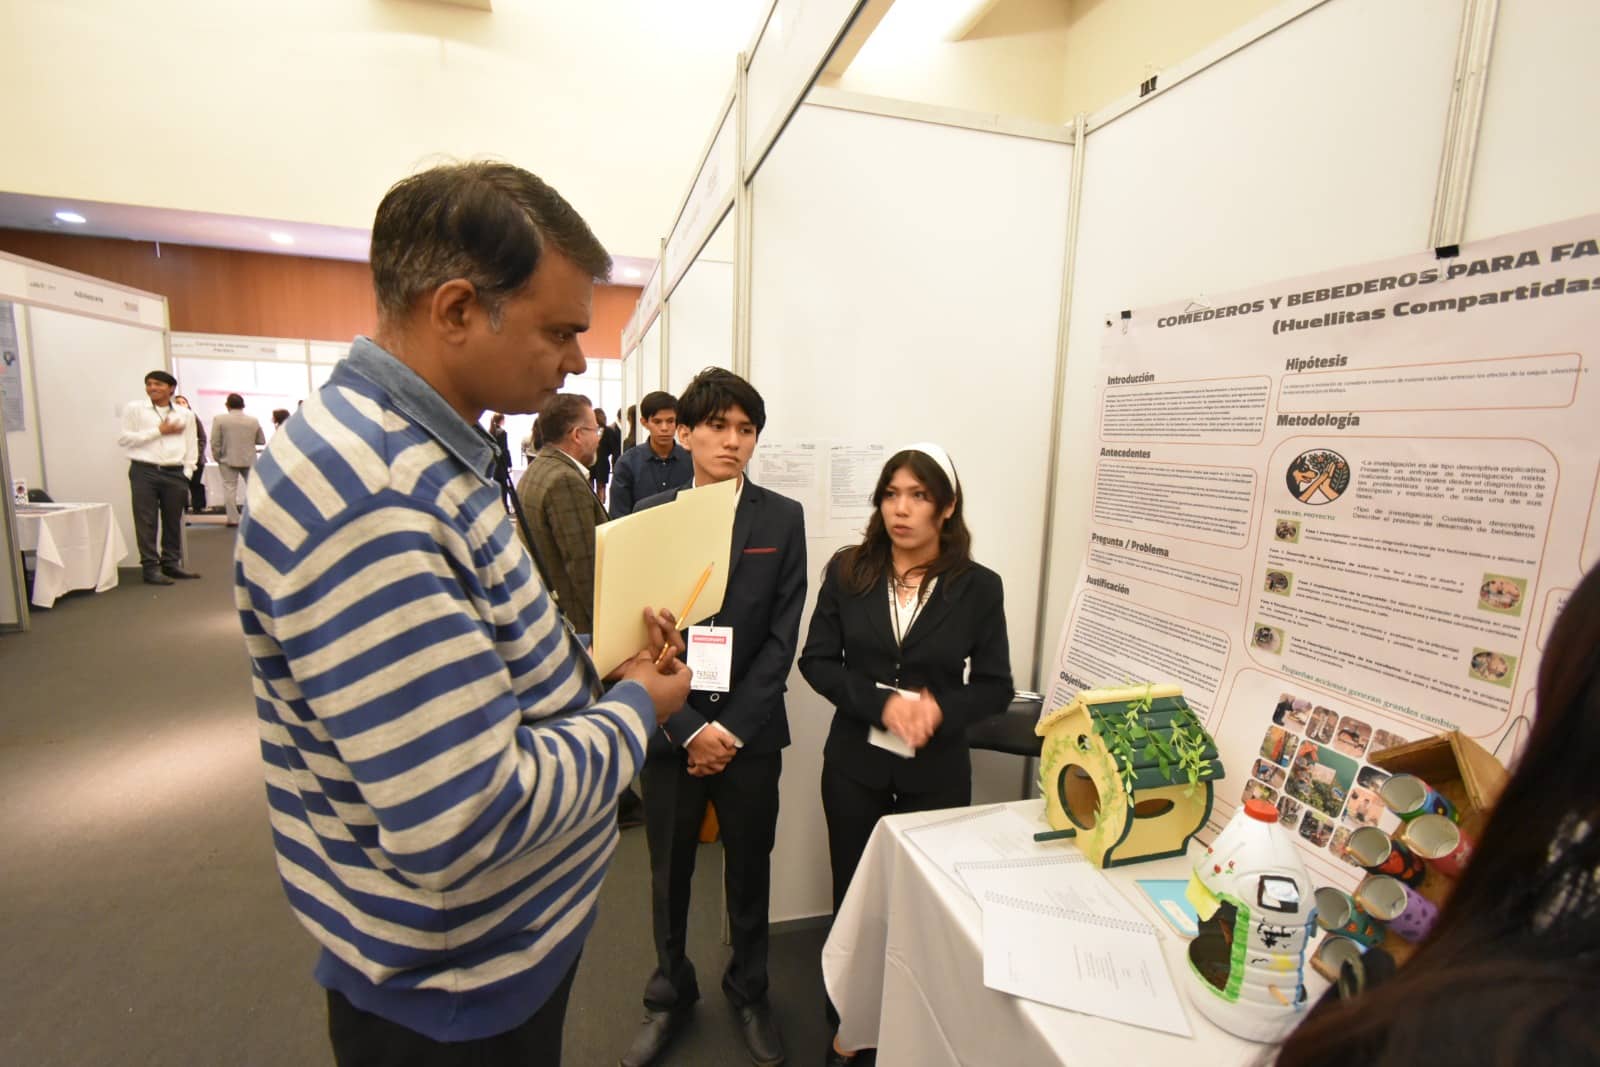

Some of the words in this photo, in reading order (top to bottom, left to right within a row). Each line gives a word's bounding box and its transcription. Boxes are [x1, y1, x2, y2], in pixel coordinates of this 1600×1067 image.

[1157, 300, 1265, 328] COMEDEROS
[1269, 296, 1283, 310] Y
[1287, 268, 1438, 307] BEBEDEROS
[1446, 250, 1541, 280] PARA
[1272, 308, 1386, 335] (Huellitas
[1285, 353, 1348, 373] Hipótesis
[1107, 371, 1155, 385] Introducción
[1276, 412, 1360, 430] Metodología
[1100, 447, 1151, 459] Antecedentes
[1091, 532, 1124, 548] Pregunta
[1125, 539, 1131, 549] /
[1131, 540, 1169, 557] Problema
[1086, 575, 1130, 595] Justificación
[1314, 676, 1347, 692] acciones
[1348, 686, 1382, 704] generan
[1383, 697, 1419, 716] grandes
